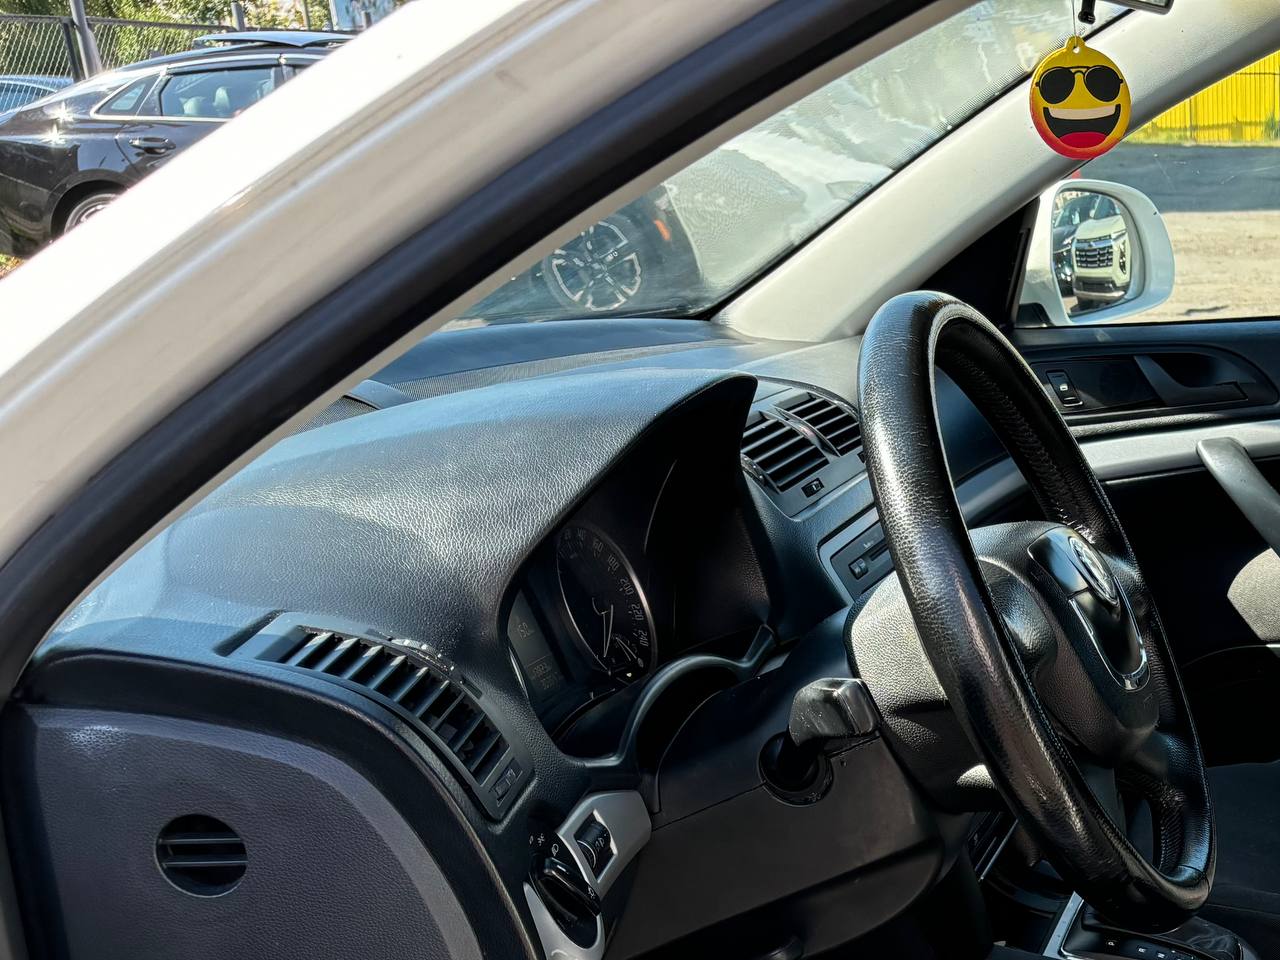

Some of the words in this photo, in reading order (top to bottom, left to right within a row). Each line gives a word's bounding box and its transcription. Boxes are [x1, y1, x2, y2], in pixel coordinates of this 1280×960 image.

[619, 577, 634, 596] 200
[631, 604, 644, 620] 220
[639, 629, 649, 647] 240
